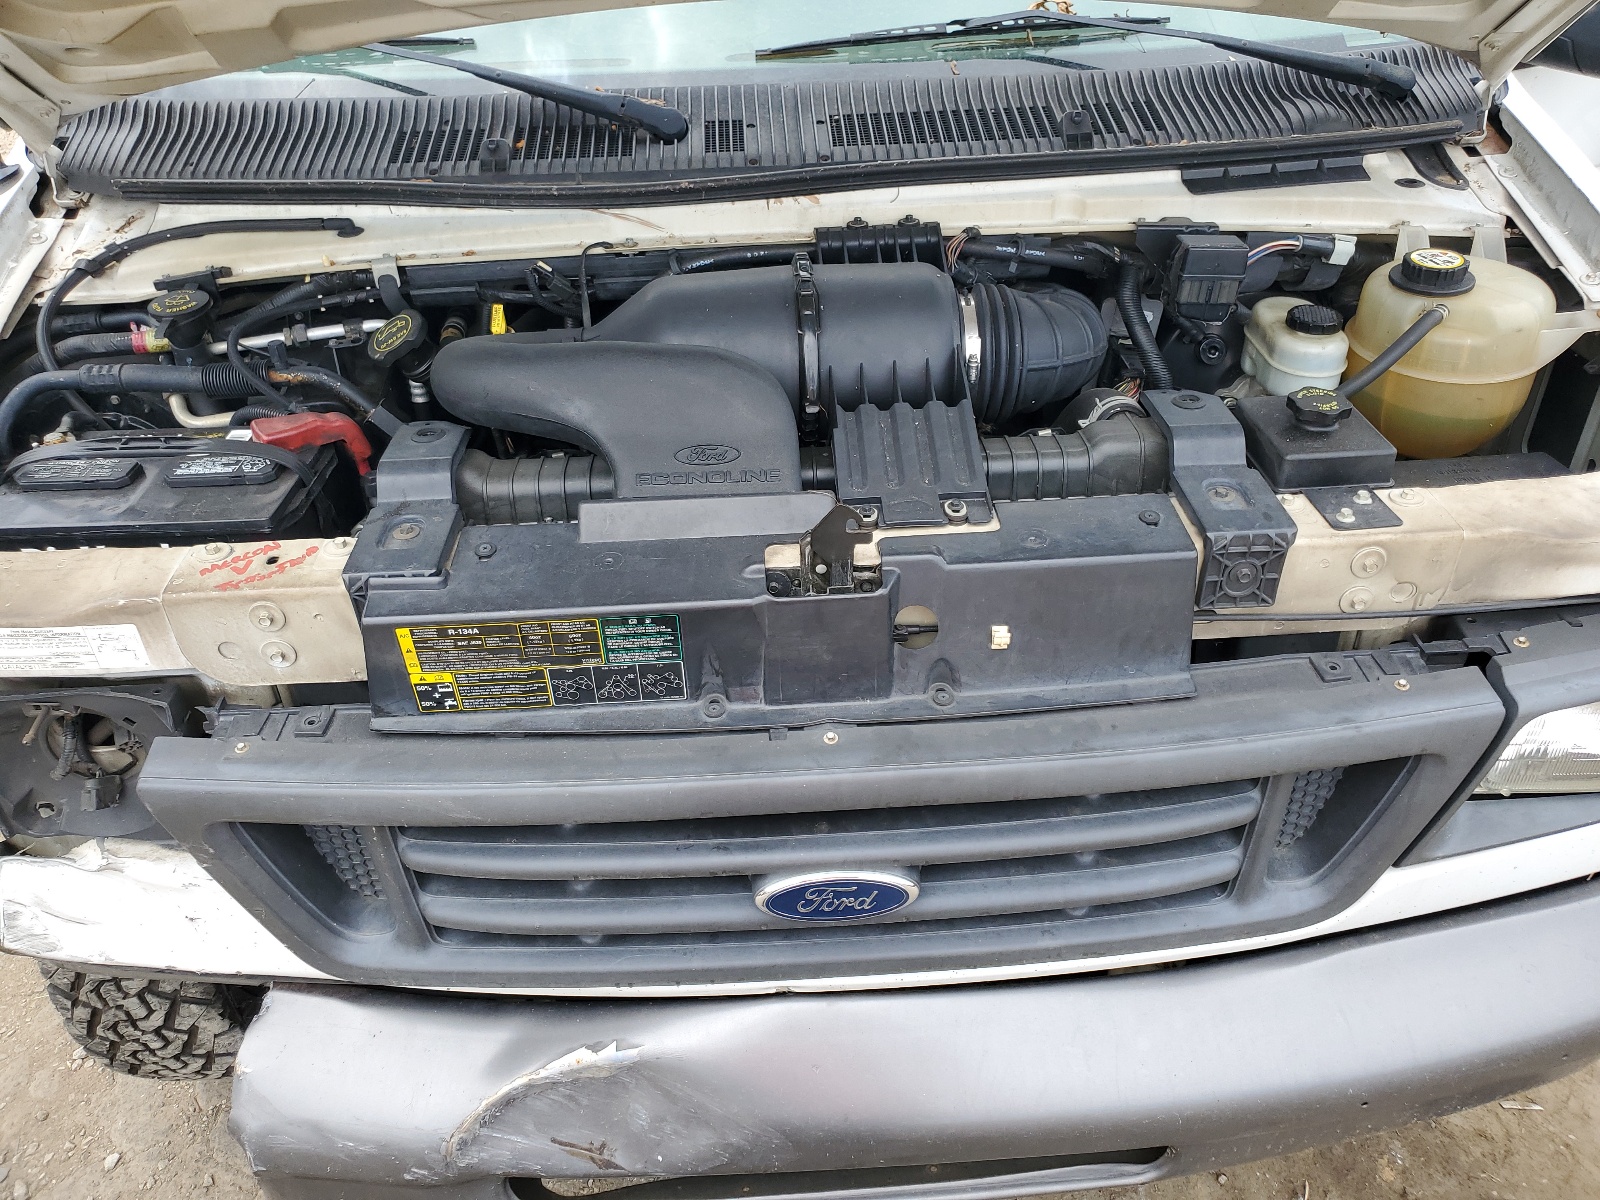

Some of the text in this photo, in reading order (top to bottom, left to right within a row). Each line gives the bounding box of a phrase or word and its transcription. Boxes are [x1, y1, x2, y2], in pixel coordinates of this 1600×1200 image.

[686, 446, 729, 462] Ford
[635, 468, 782, 487] ECONOLINE
[447, 627, 480, 636] R-134A
[797, 886, 879, 913] Ford
